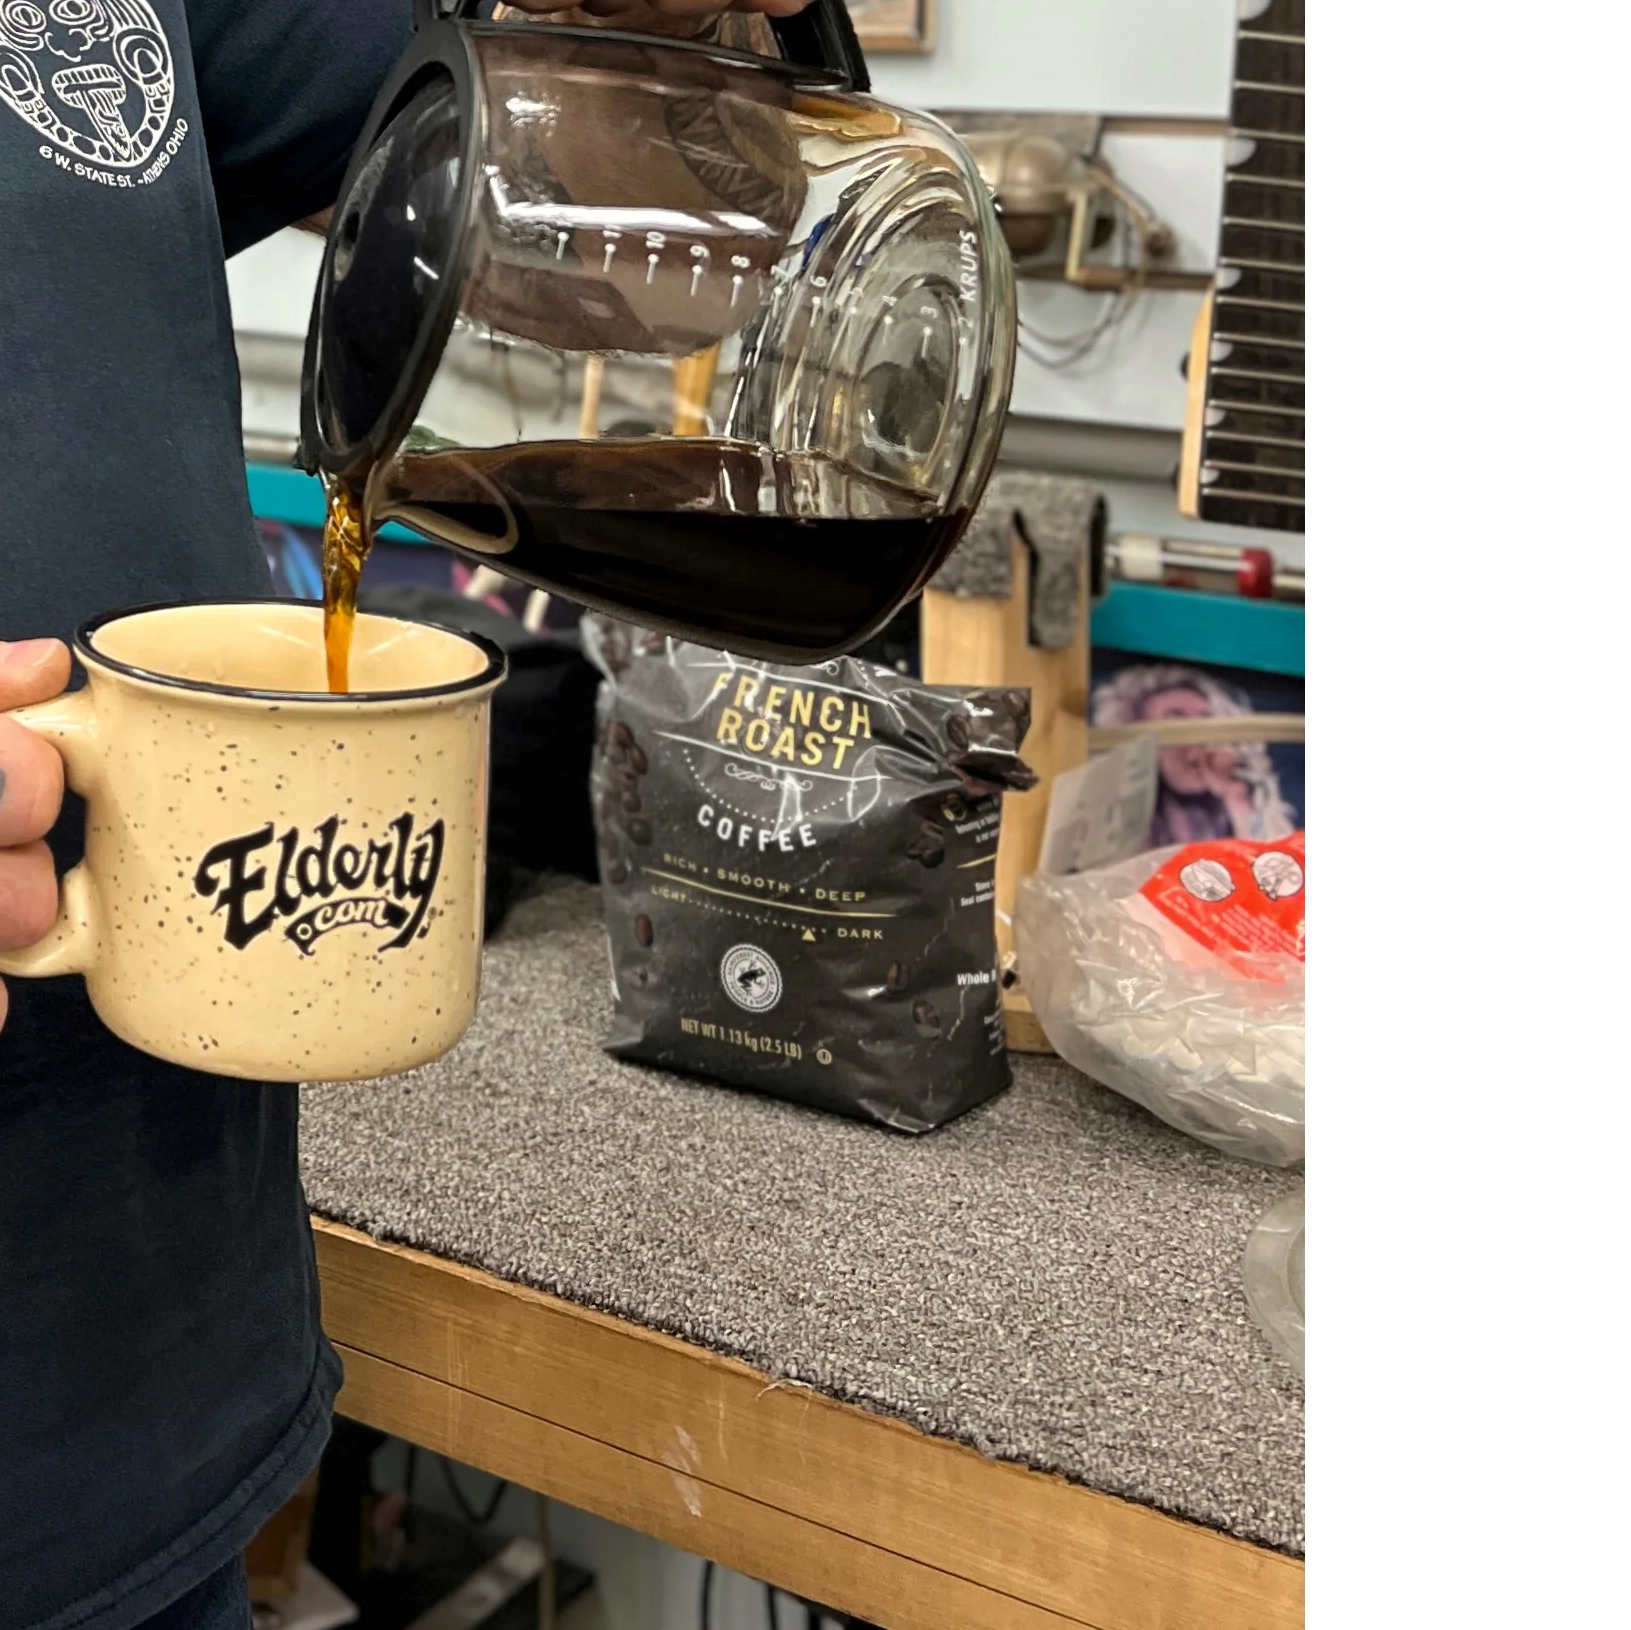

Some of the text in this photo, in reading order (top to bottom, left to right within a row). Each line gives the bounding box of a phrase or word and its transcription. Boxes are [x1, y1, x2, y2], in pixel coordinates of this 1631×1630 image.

[39, 145, 53, 159] 6
[55, 152, 72, 171] W.
[74, 162, 117, 187] STATE
[117, 174, 135, 188] ST.
[166, 118, 189, 155] OHIO
[731, 255, 751, 268] 8
[958, 229, 979, 303] KRUPS
[713, 672, 872, 740] FRENCH
[716, 707, 855, 770] ROAST
[697, 804, 817, 852] COFFEE
[193, 811, 445, 952] Elderly
[664, 853, 866, 902] RICH SMOOTH DEEP
[651, 886, 883, 940] LIGHT DARK
[957, 972, 990, 985] Whole
[681, 1018, 699, 1035] NET
[701, 1023, 717, 1039] WT
[719, 1026, 742, 1045] 1.13
[744, 1031, 758, 1052] kg
